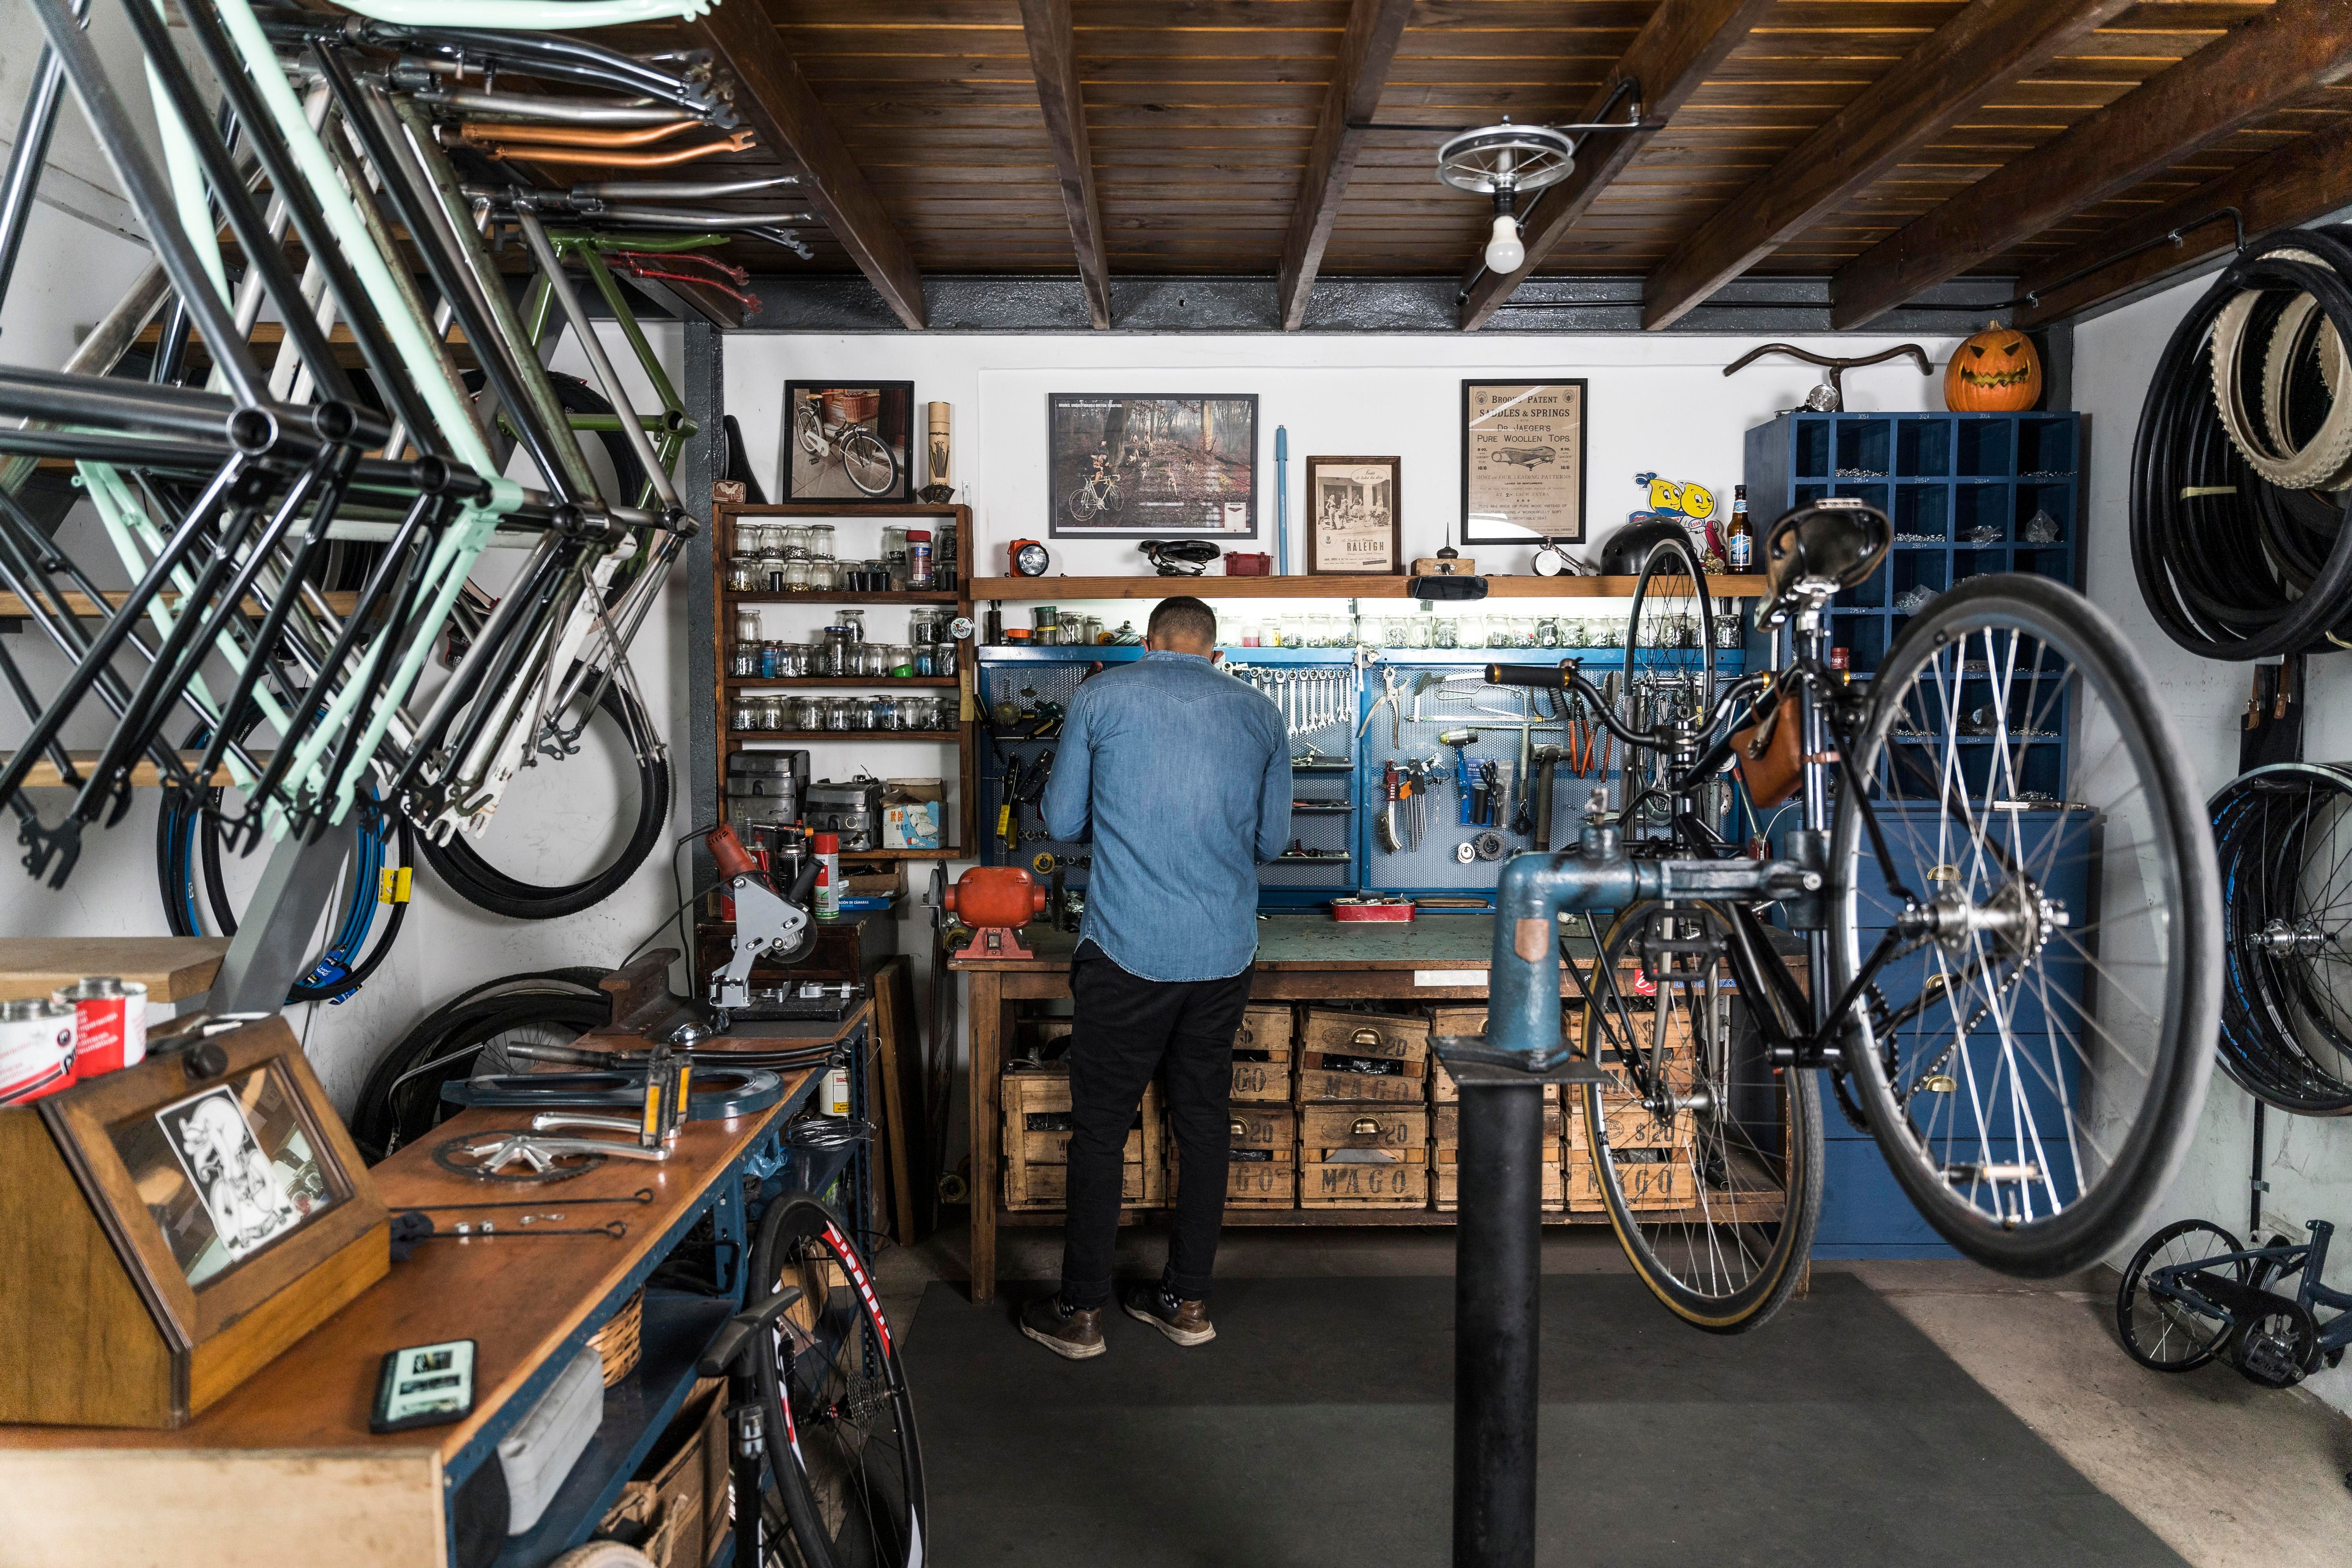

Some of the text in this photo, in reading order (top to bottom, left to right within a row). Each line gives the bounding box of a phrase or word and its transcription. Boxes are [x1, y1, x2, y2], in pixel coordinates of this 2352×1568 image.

[1479, 409, 1520, 417] SADDLES
[1530, 409, 1570, 417] SPRINGS
[1347, 541, 1384, 552] RALEIGH
[1234, 1067, 1266, 1093] GO
[1236, 1166, 1273, 1192] GO
[1321, 1168, 1406, 1194] MAGO
